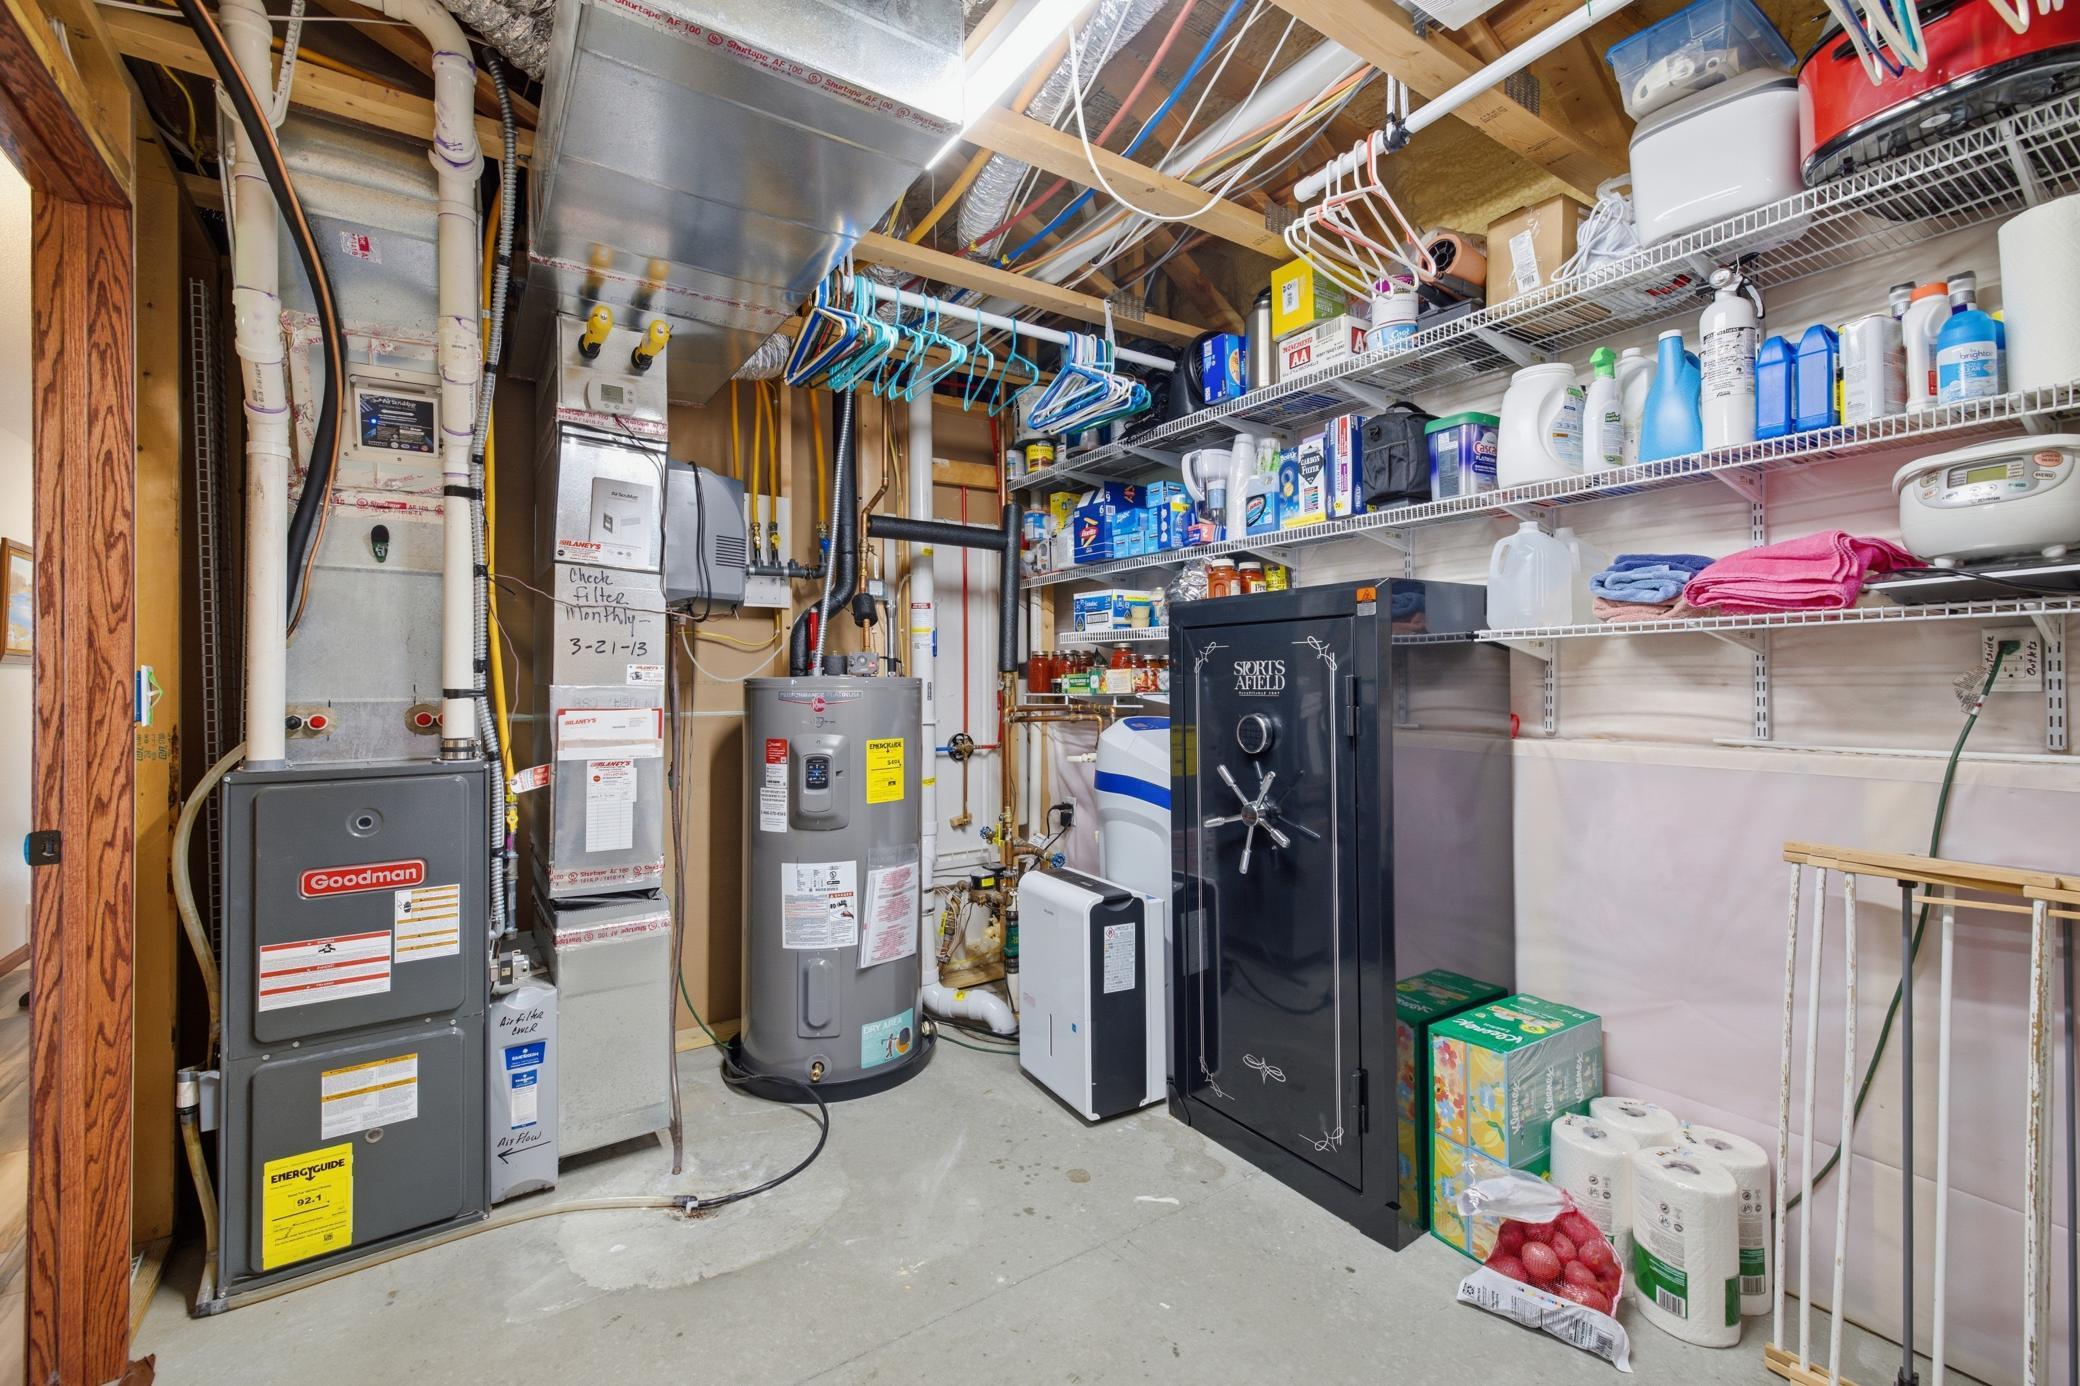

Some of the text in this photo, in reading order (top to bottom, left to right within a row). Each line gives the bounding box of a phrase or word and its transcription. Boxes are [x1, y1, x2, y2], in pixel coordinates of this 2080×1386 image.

[666, 16, 681, 26] AF
[685, 23, 701, 36] 100
[727, 39, 803, 75] Shurtape AF 100
[825, 78, 863, 98] Shurtape
[1290, 347, 1310, 368] AA
[570, 567, 613, 586] Check
[569, 637, 648, 657] 3-21-13
[1233, 660, 1286, 676] SPORTS
[1234, 675, 1286, 690] AFIELD
[310, 866, 417, 890] Goodman
[1452, 1018, 1523, 1044] Kleenex
[270, 1158, 345, 1185] ENERGYGUIDE
[296, 1193, 323, 1208] 92.1
